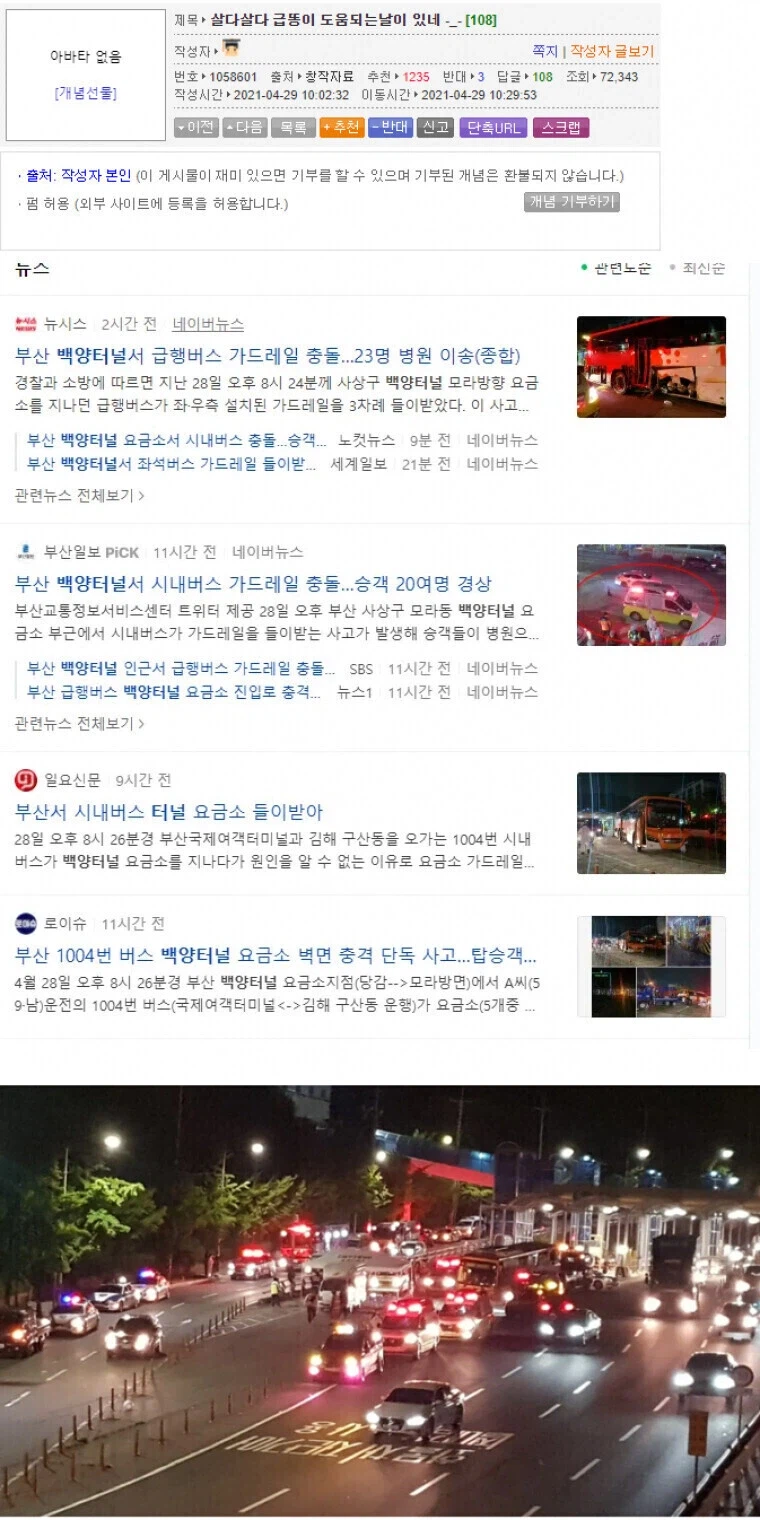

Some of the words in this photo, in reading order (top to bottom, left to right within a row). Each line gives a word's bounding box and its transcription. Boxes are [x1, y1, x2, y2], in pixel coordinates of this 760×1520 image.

[174, 13, 199, 27] 제목
[210, 12, 270, 27] 살다살다
[272, 12, 315, 27] 급똥이
[319, 12, 407, 27] 도움되는날이
[412, 12, 441, 27] 있네
[50, 49, 91, 64] 아바타
[95, 49, 123, 65] 없음
[174, 45, 211, 59] 작성자
[532, 44, 558, 59] 쪽지
[570, 44, 612, 59] 작성자
[614, 44, 654, 59] 글보기
[174, 70, 199, 84] 번호
[209, 71, 257, 83] 1058601
[270, 70, 294, 84] 출처
[305, 70, 355, 84] 창작자료
[367, 70, 391, 84] 추천
[403, 71, 430, 83] 1235
[443, 70, 466, 84] 반대
[477, 71, 486, 83] 3
[497, 70, 522, 84] 답글
[532, 71, 554, 83] 108
[566, 70, 590, 83] 조회
[600, 71, 639, 83] 72,343
[174, 88, 224, 102] 작성시간
[233, 89, 298, 101] 2021-04-29
[302, 89, 350, 101] 10:02:32
[361, 88, 411, 102] 이동시간
[421, 89, 486, 101] 2021-04-29
[489, 89, 538, 101] 10:29:53
[188, 120, 213, 134] 이전
[236, 120, 262, 134] 다음
[281, 121, 307, 135] 목록
[334, 120, 359, 134] 추천
[382, 120, 408, 134] 반대
[423, 120, 449, 134] 신고
[468, 121, 521, 135] 단축URL
[541, 121, 581, 135] 스크랩
[26, 196, 39, 211] 펌
[43, 196, 70, 211] 허용
[110, 196, 163, 211] 사이트에
[167, 196, 208, 211] 등록을
[531, 195, 555, 209] 개념
[562, 194, 614, 209] 기부하기
[14, 262, 51, 278] 뉴스
[43, 316, 87, 332] 뉴시스
[101, 316, 139, 332] 2시간
[143, 316, 157, 332] 전
[173, 316, 245, 332] 네이버뉴스
[14, 347, 50, 366] 부산
[56, 346, 144, 366] 백양터널서
[151, 346, 223, 366] 급행버스
[229, 346, 299, 366] 가드레일
[399, 347, 432, 365] 병원
[14, 488, 72, 504] 관련뉴스
[77, 488, 133, 504] 전체보기
[43, 544, 102, 560] 부산일보
[105, 546, 140, 559] PiCK
[154, 544, 198, 560] 11시간
[203, 544, 217, 560] 전
[232, 544, 304, 560] 네이버뉴스
[14, 575, 50, 594] 부산
[56, 575, 144, 594] 백양터널서
[151, 575, 222, 594] 시내버스
[228, 575, 298, 594] 가드레일
[395, 575, 449, 594] 20여명
[457, 575, 493, 593] 경상
[14, 603, 172, 619] 부산교통정보서비스센터
[177, 603, 220, 619] 트위터
[226, 603, 255, 619] 제공
[259, 603, 289, 619] 28일
[294, 603, 323, 619] 오후
[327, 603, 357, 619] 부산
[361, 603, 405, 619] 사상구
[409, 603, 453, 619] 모라동
[458, 603, 515, 619] 백양터널
[520, 604, 535, 617] 요
[349, 663, 374, 675] SBS
[44, 772, 102, 788] 일요신문
[115, 772, 153, 788] 9시간
[158, 772, 171, 788] 전
[14, 803, 67, 822] 부산서
[74, 803, 145, 822] 시내버스
[151, 803, 186, 822] 터널
[193, 803, 246, 821] 요금소
[252, 803, 324, 822] 들이받아
[43, 916, 87, 932] 로이슈
[102, 916, 146, 932] 11시간
[151, 916, 164, 932] 전
